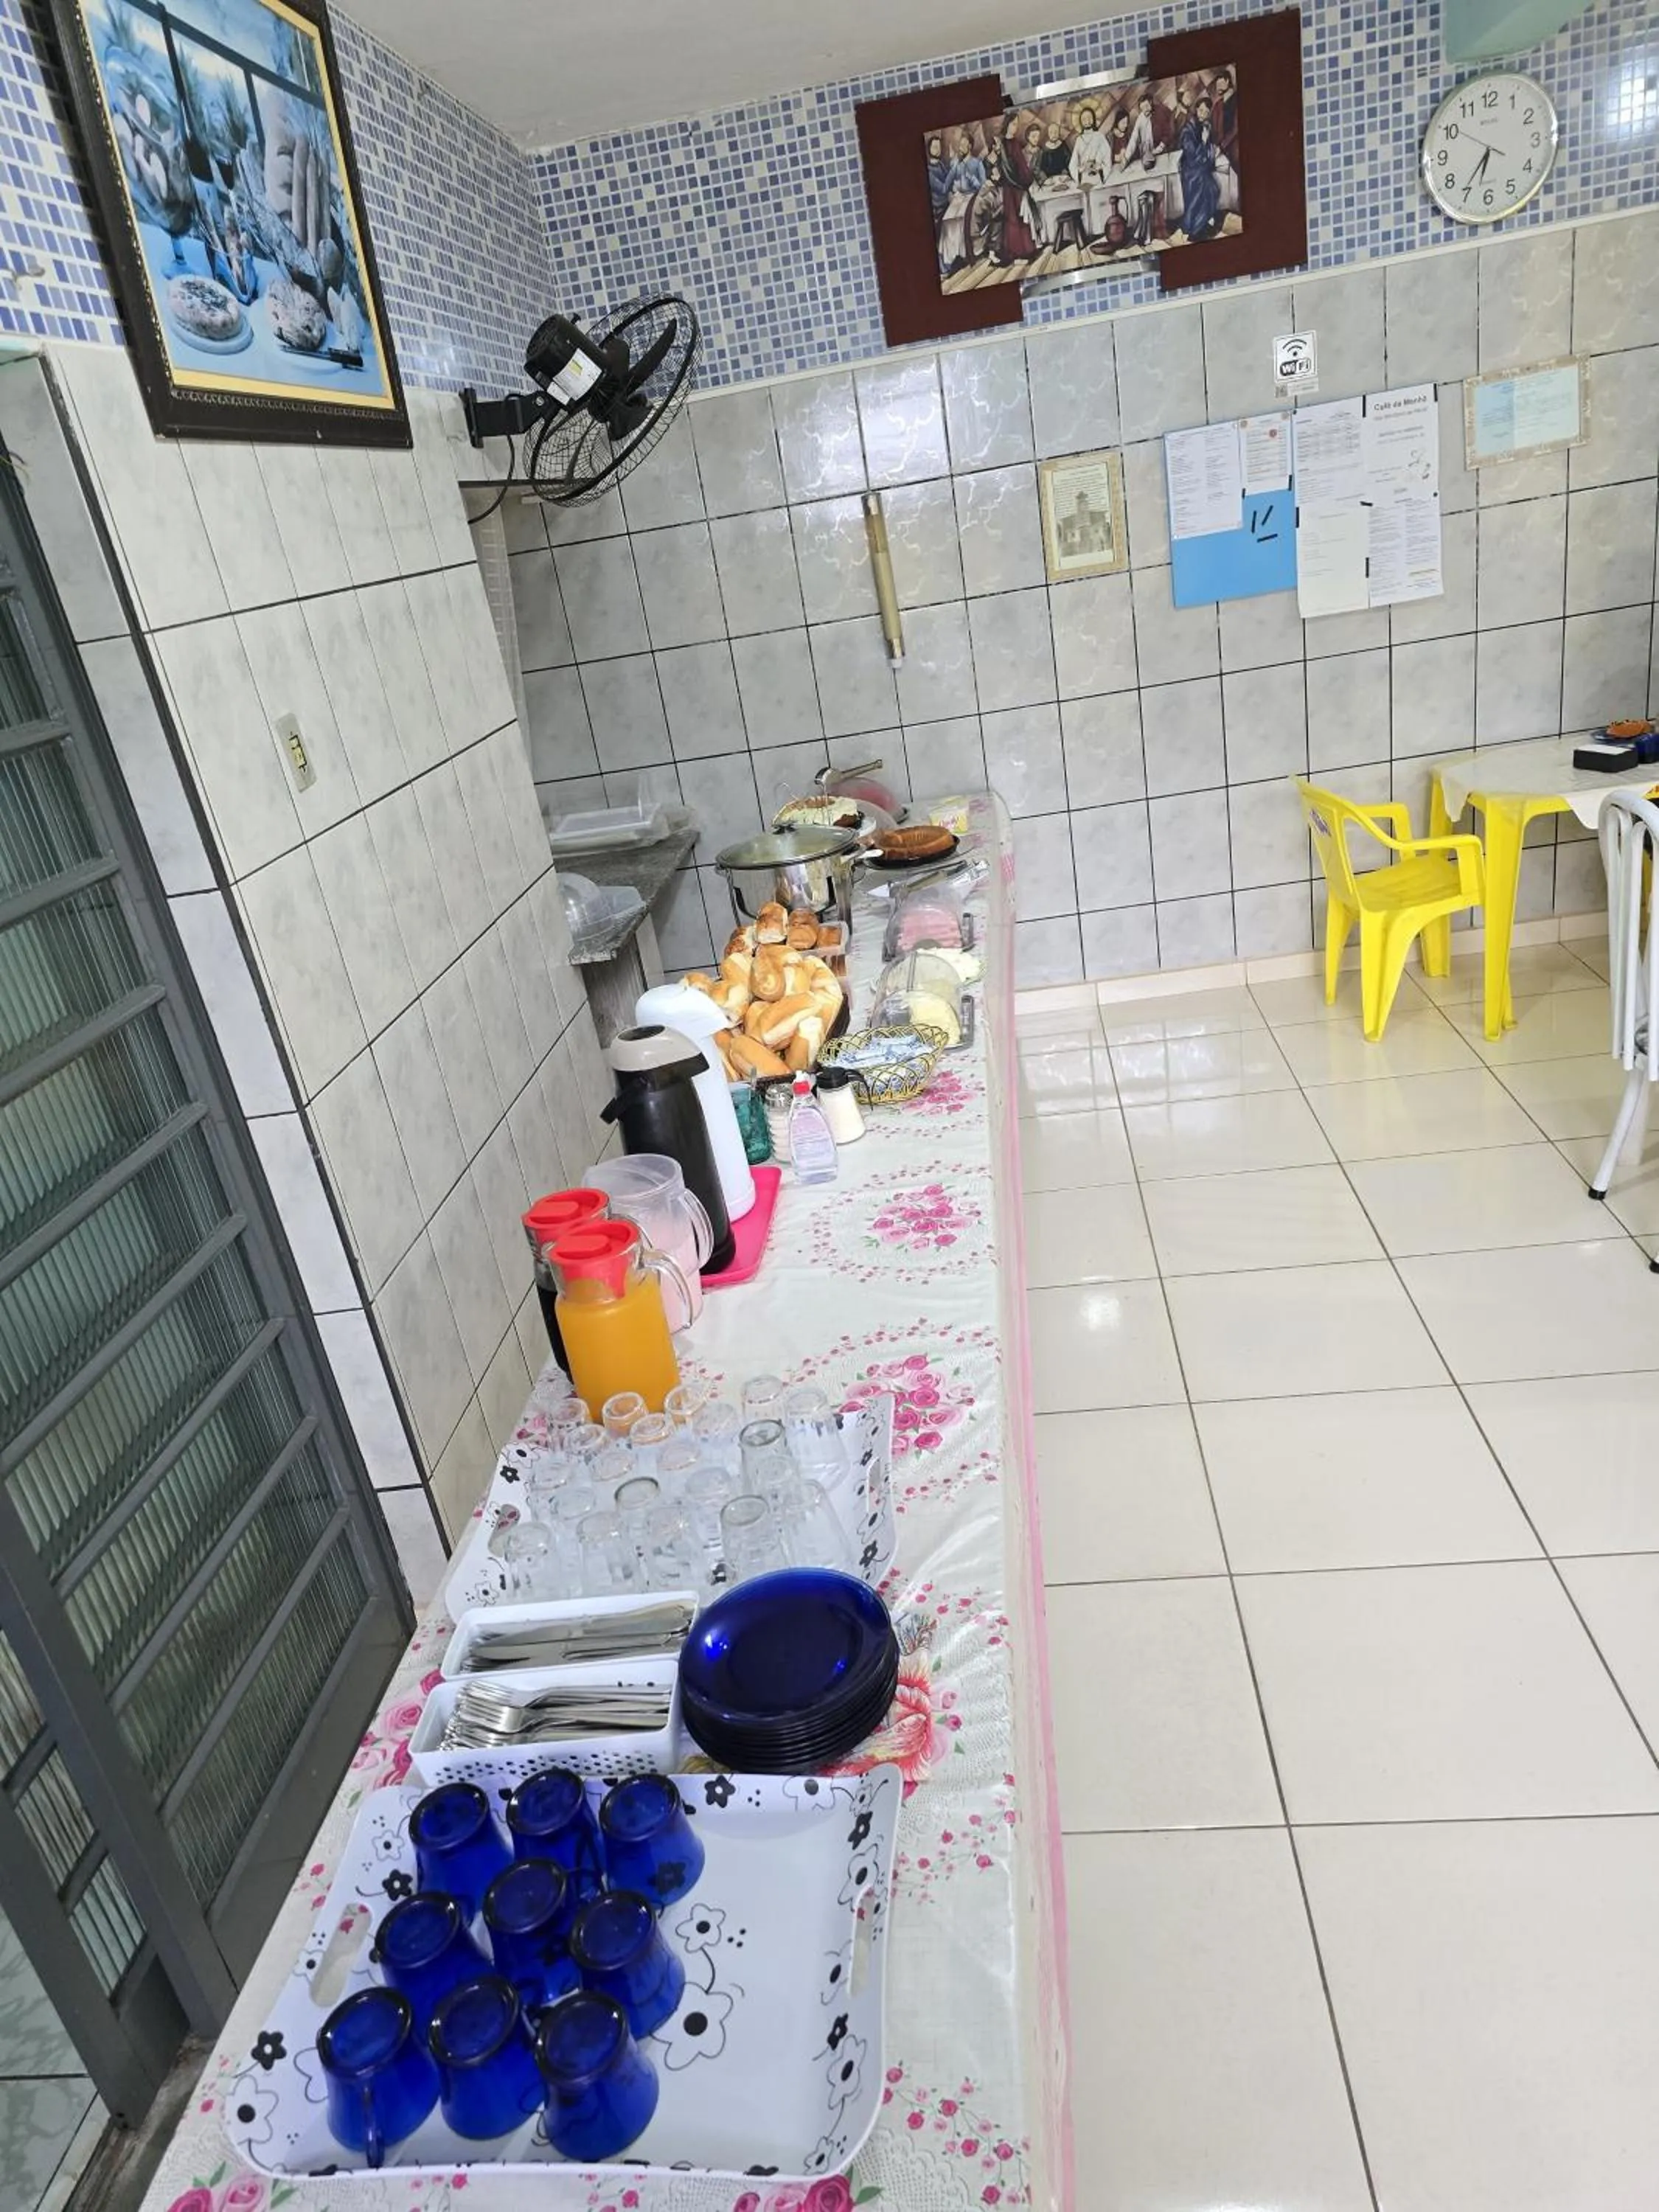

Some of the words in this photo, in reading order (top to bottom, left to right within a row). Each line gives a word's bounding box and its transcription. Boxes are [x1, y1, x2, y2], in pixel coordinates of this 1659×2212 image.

[1481, 91, 1498, 108] 12
[1509, 94, 1515, 109] 1
[1460, 100, 1474, 118] 11
[1523, 108, 1534, 125] 2
[1443, 123, 1459, 139] 10
[1531, 132, 1540, 148] 3
[1437, 150, 1448, 166] 9
[1523, 158, 1533, 173] 4
[1444, 173, 1455, 189] 8
[1506, 178, 1516, 195] 5
[1462, 187, 1472, 203] 7
[1484, 189, 1494, 205] 6
